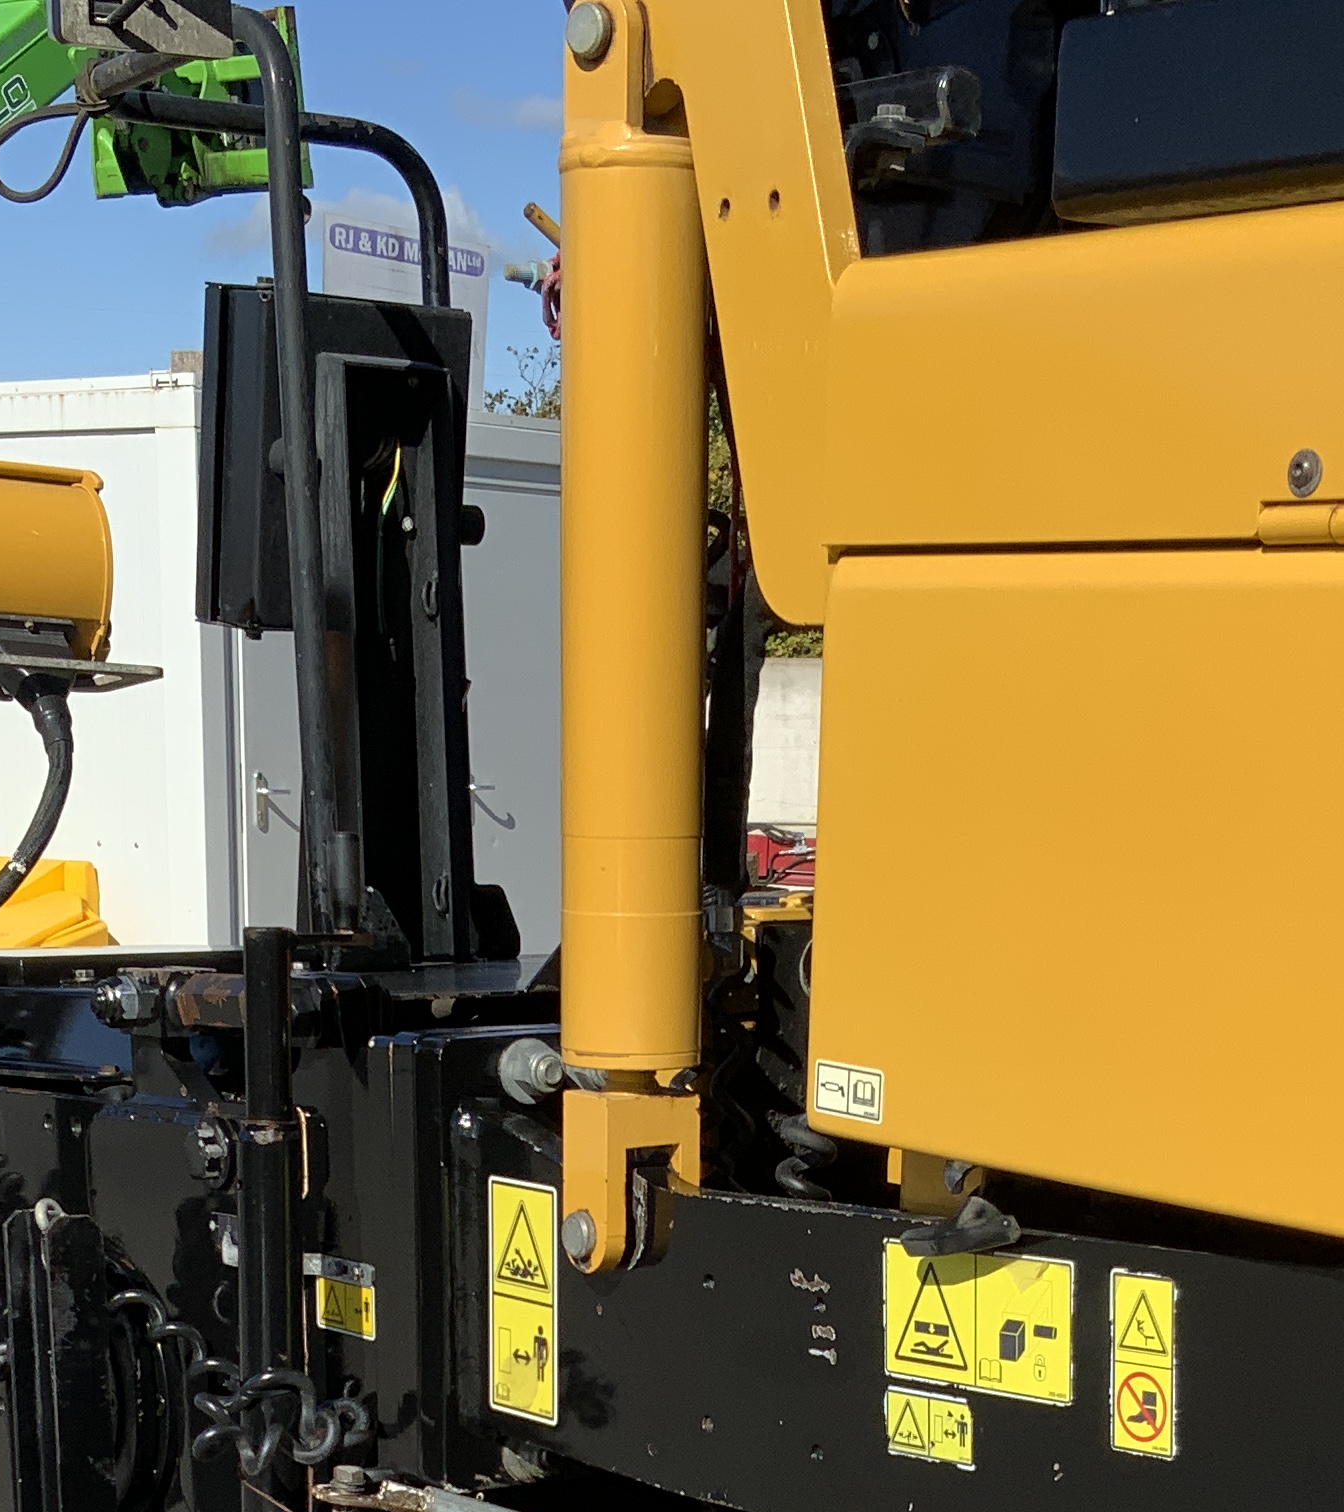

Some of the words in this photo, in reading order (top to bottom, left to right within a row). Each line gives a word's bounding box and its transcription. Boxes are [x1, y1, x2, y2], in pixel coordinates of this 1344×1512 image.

[335, 227, 354, 249] RJ
[358, 232, 372, 253] &
[376, 235, 400, 257] KD
[404, 241, 467, 272] MAN
